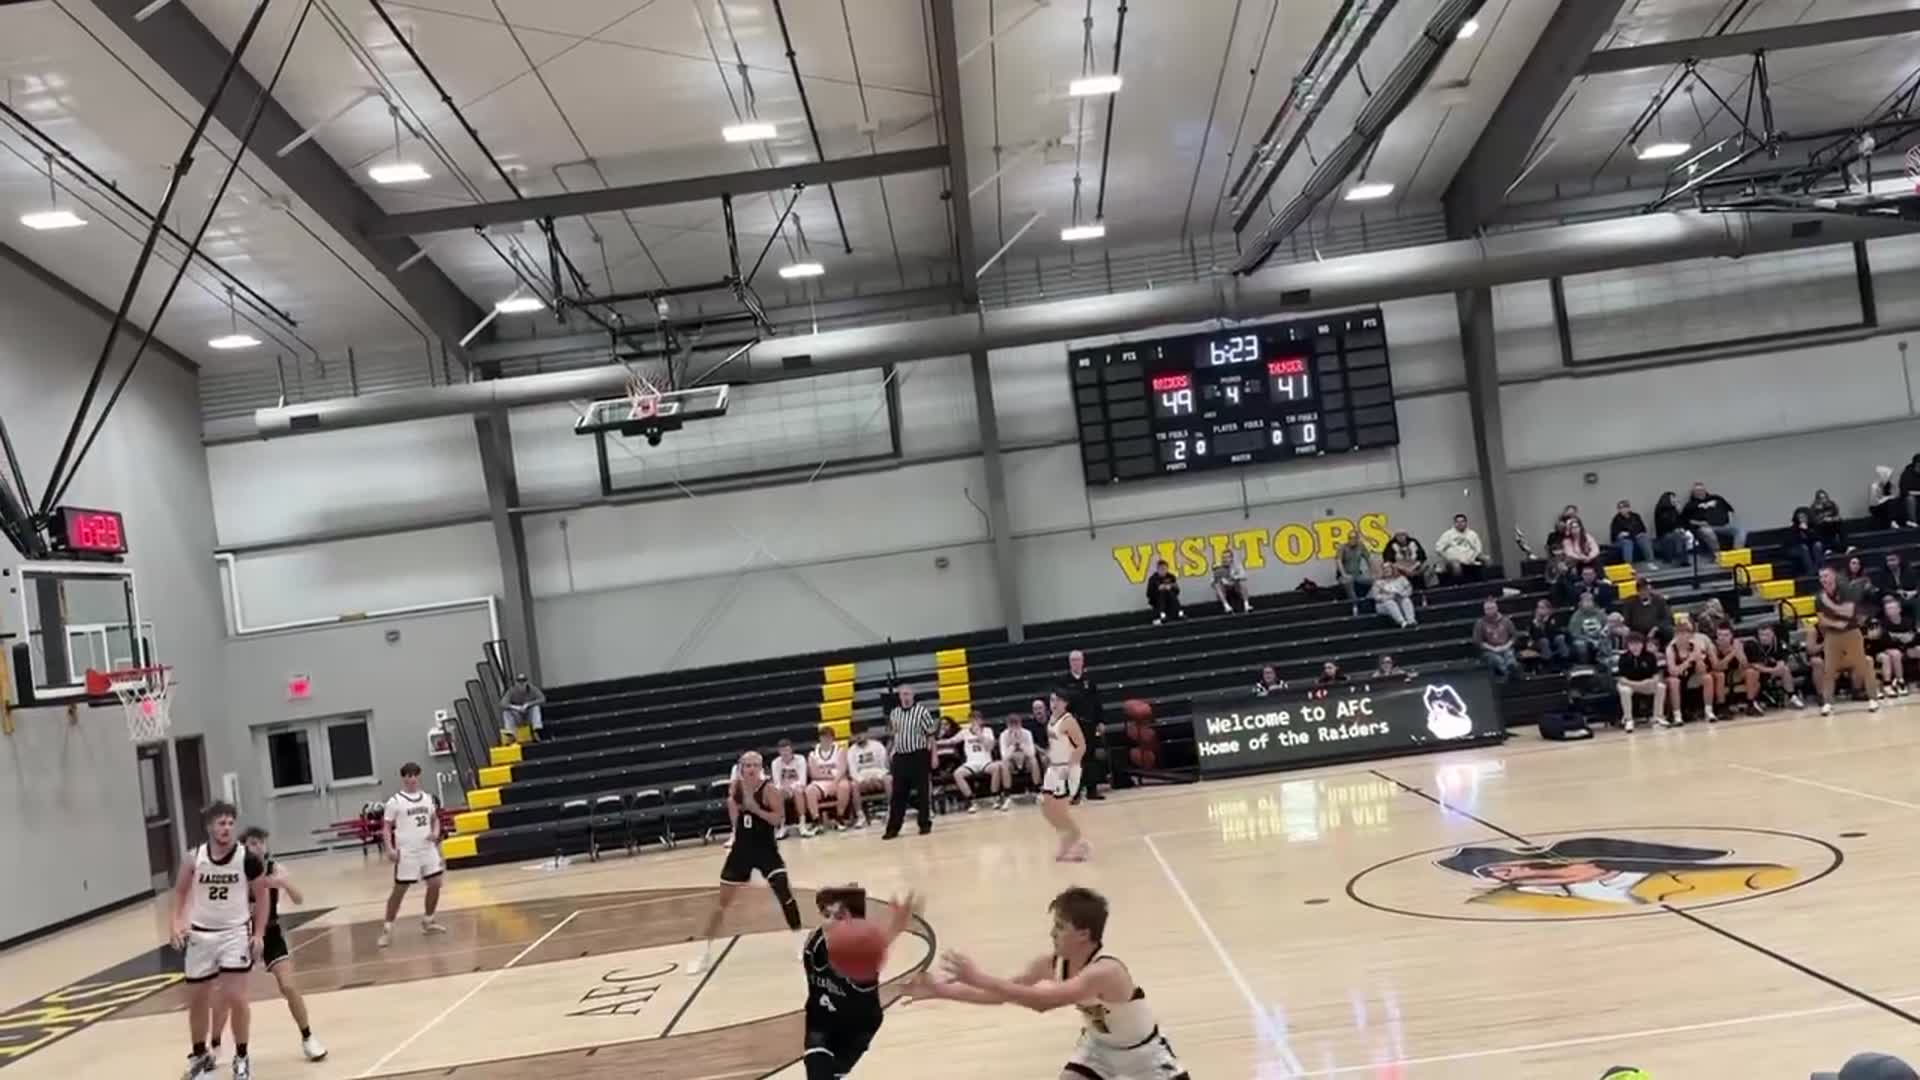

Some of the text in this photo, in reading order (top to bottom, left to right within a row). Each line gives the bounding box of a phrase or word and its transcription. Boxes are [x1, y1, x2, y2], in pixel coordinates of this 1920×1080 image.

[1210, 335, 1258, 366] 6:23
[1226, 386, 1239, 403] 4
[1277, 374, 1309, 399] 41
[1162, 389, 1193, 415] 49
[1213, 419, 1265, 433] PLAYER FOULS
[1303, 423, 1315, 443] 0
[1272, 429, 1283, 445] 0
[1174, 441, 1186, 460] 2
[1113, 512, 1391, 585] VISITORS
[1206, 698, 1374, 736] Welcome to AFC
[1199, 719, 1391, 757] Home of the Raiders
[743, 813, 753, 829] 0
[208, 886, 229, 901] 22
